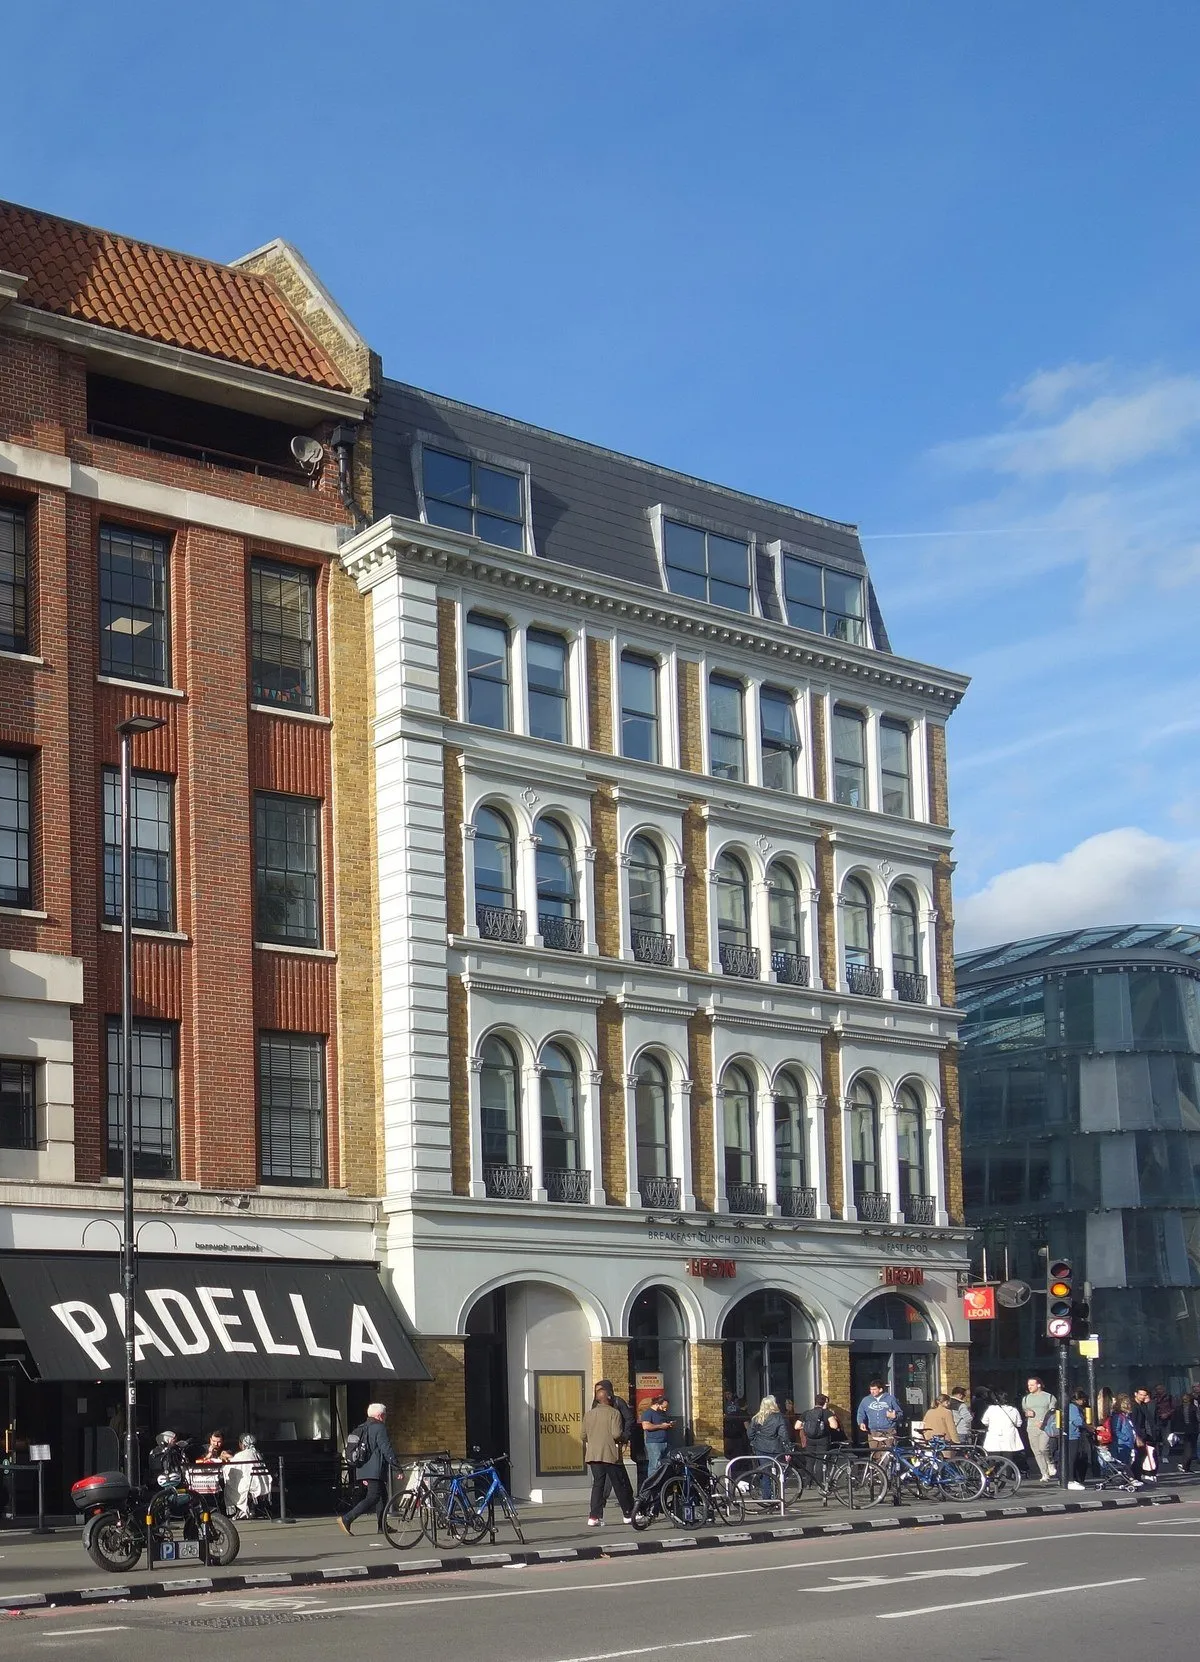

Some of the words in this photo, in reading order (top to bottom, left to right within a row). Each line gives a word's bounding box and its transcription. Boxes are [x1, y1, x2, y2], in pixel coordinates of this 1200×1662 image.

[648, 1231, 697, 1242] BREAKFAST
[700, 1234, 731, 1244] LUNCH
[734, 1235, 767, 1246] DINNER
[886, 1242, 904, 1252] FAST
[907, 1243, 928, 1253] FOOD
[968, 1308, 991, 1317] LEON
[50, 1287, 395, 1370] PADELLA
[540, 1413, 581, 1421] BIRRANE
[540, 1424, 570, 1434] HOUSE
